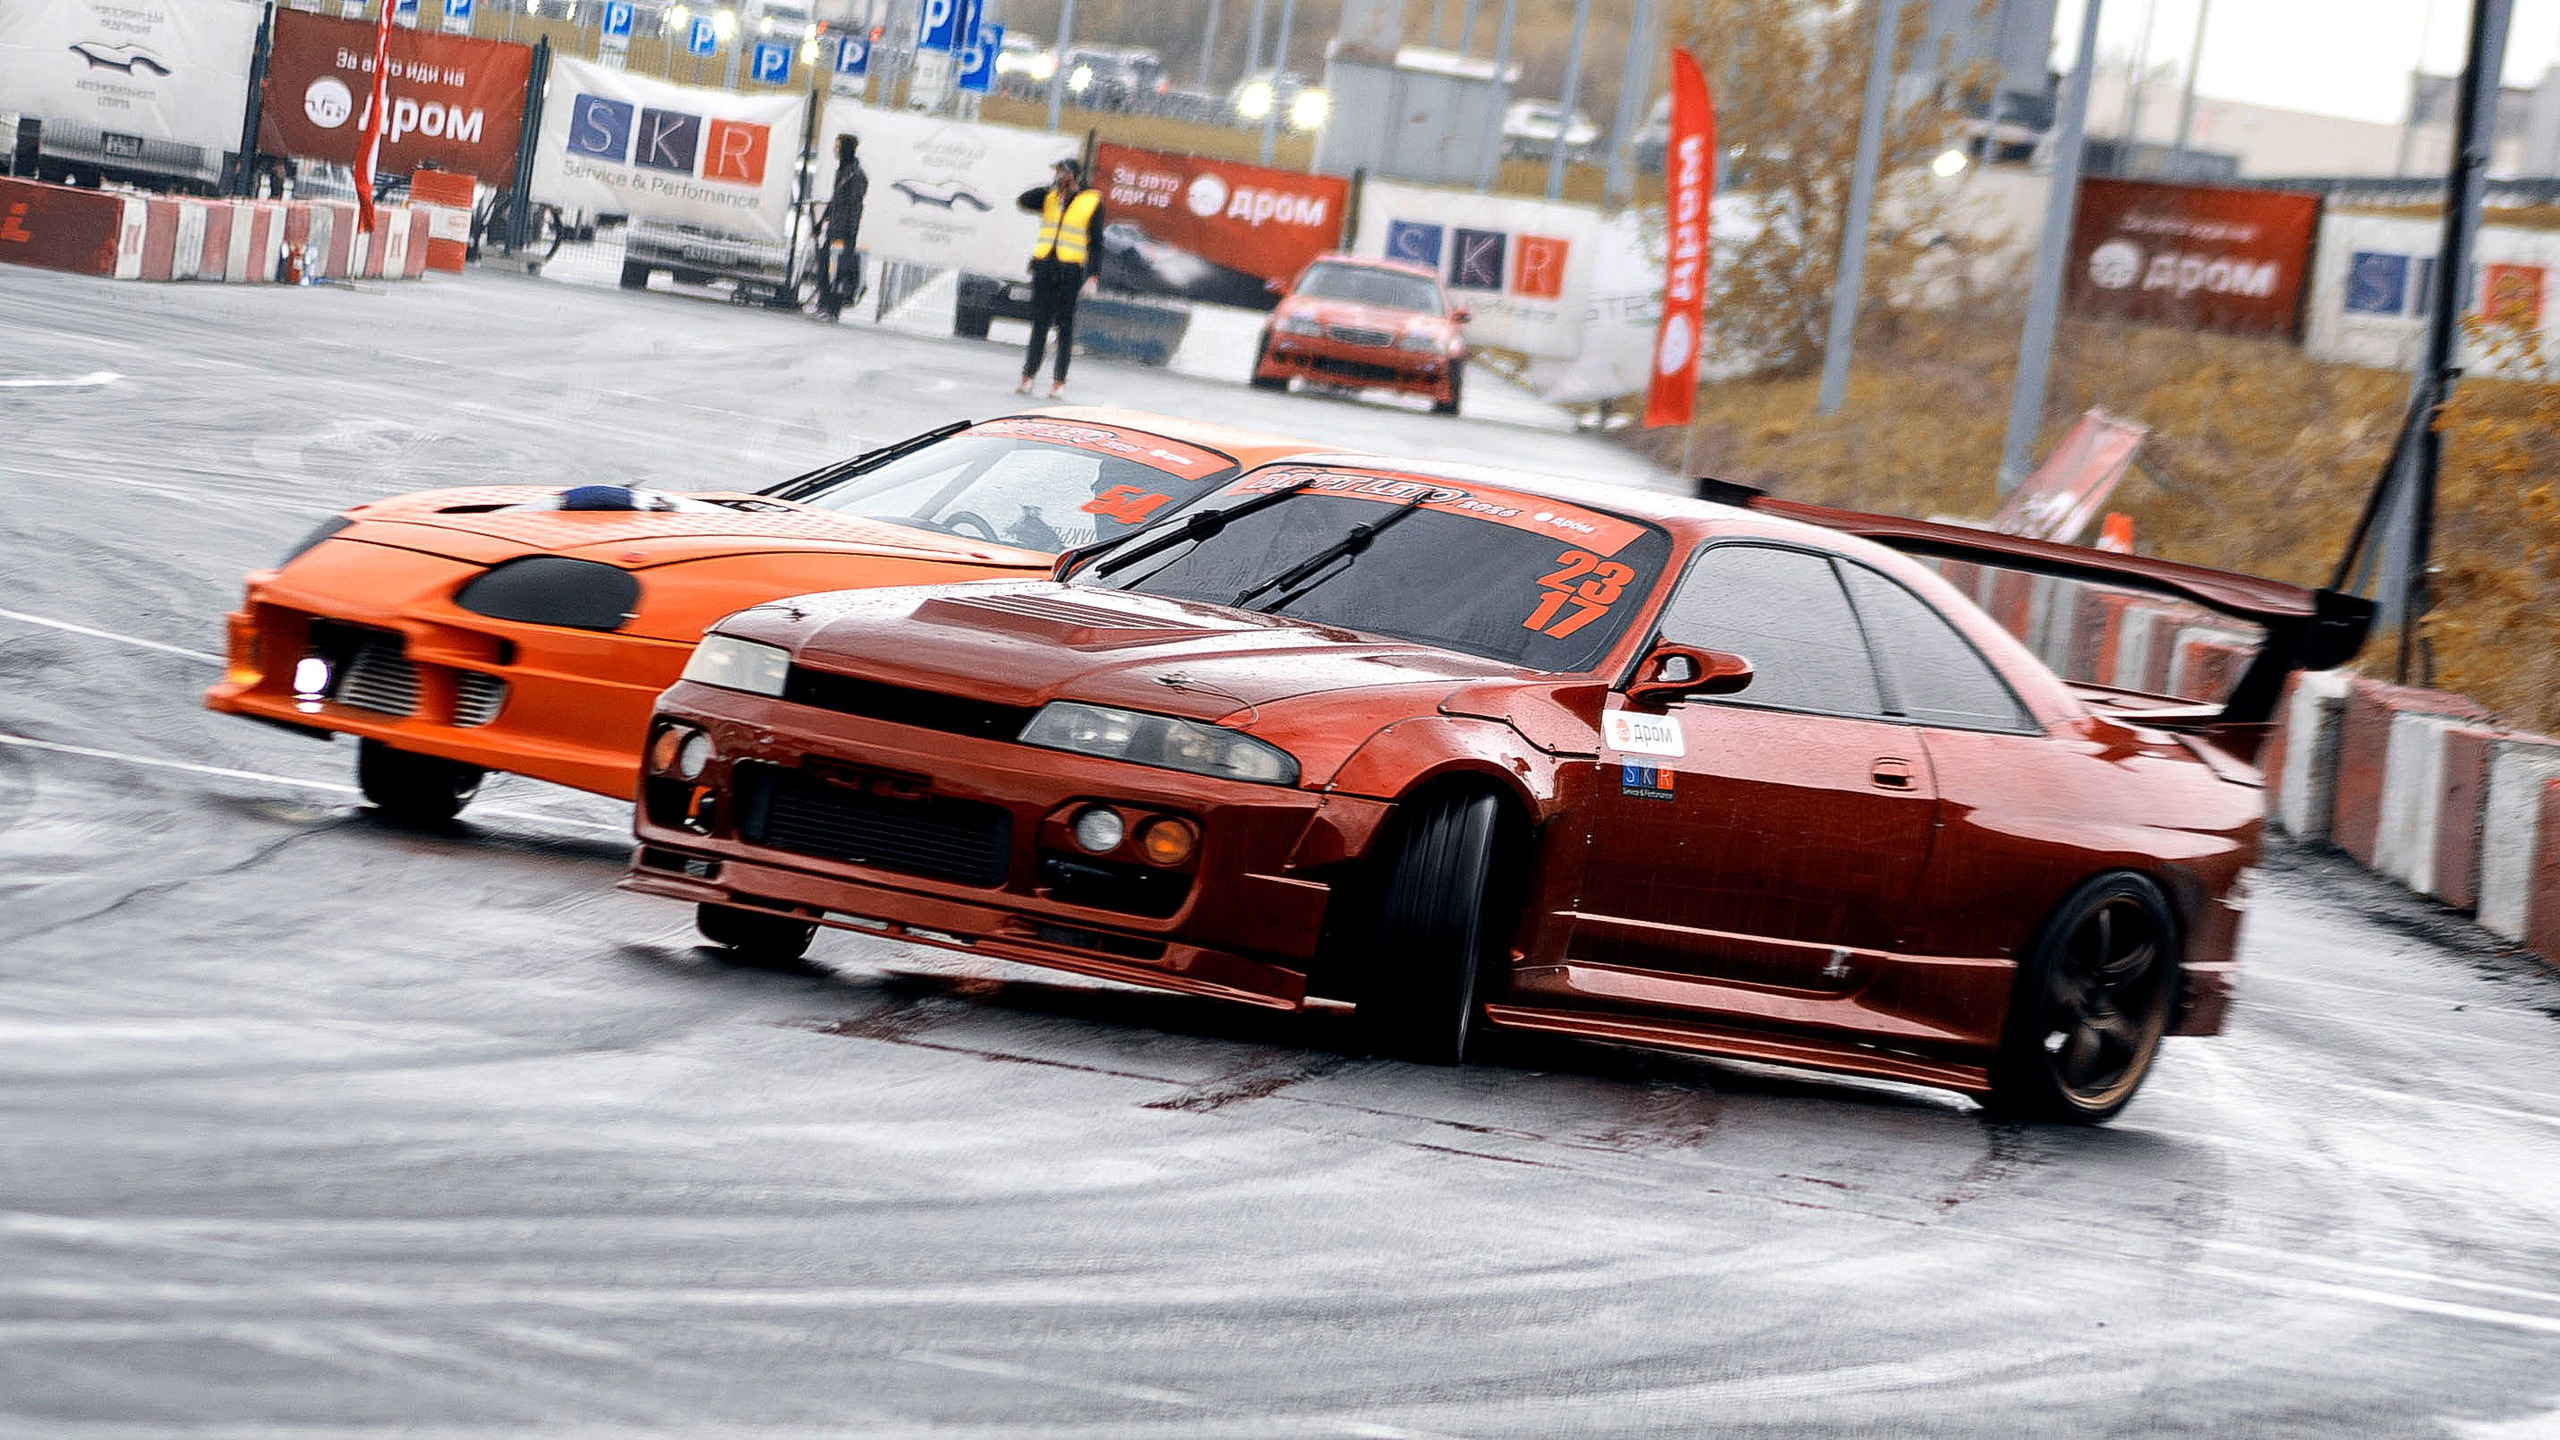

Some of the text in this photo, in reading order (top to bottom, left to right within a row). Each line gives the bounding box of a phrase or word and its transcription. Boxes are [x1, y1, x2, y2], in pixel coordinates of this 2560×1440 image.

[610, 4, 628, 35] P
[921, 0, 951, 43] P
[695, 21, 714, 51] P
[336, 48, 358, 70] За
[405, 63, 438, 84] иди
[442, 68, 465, 87] на
[760, 49, 784, 80] P
[840, 41, 863, 72] P
[580, 100, 753, 179] SKR
[562, 159, 627, 188] Service
[631, 173, 647, 191] &
[1112, 165, 1181, 193] За авто
[1109, 185, 1171, 208] иди на
[1535, 549, 1636, 605] 23
[1522, 590, 1610, 640] 17
[1633, 724, 1673, 747] дром
[1626, 761, 1669, 786] SKR
